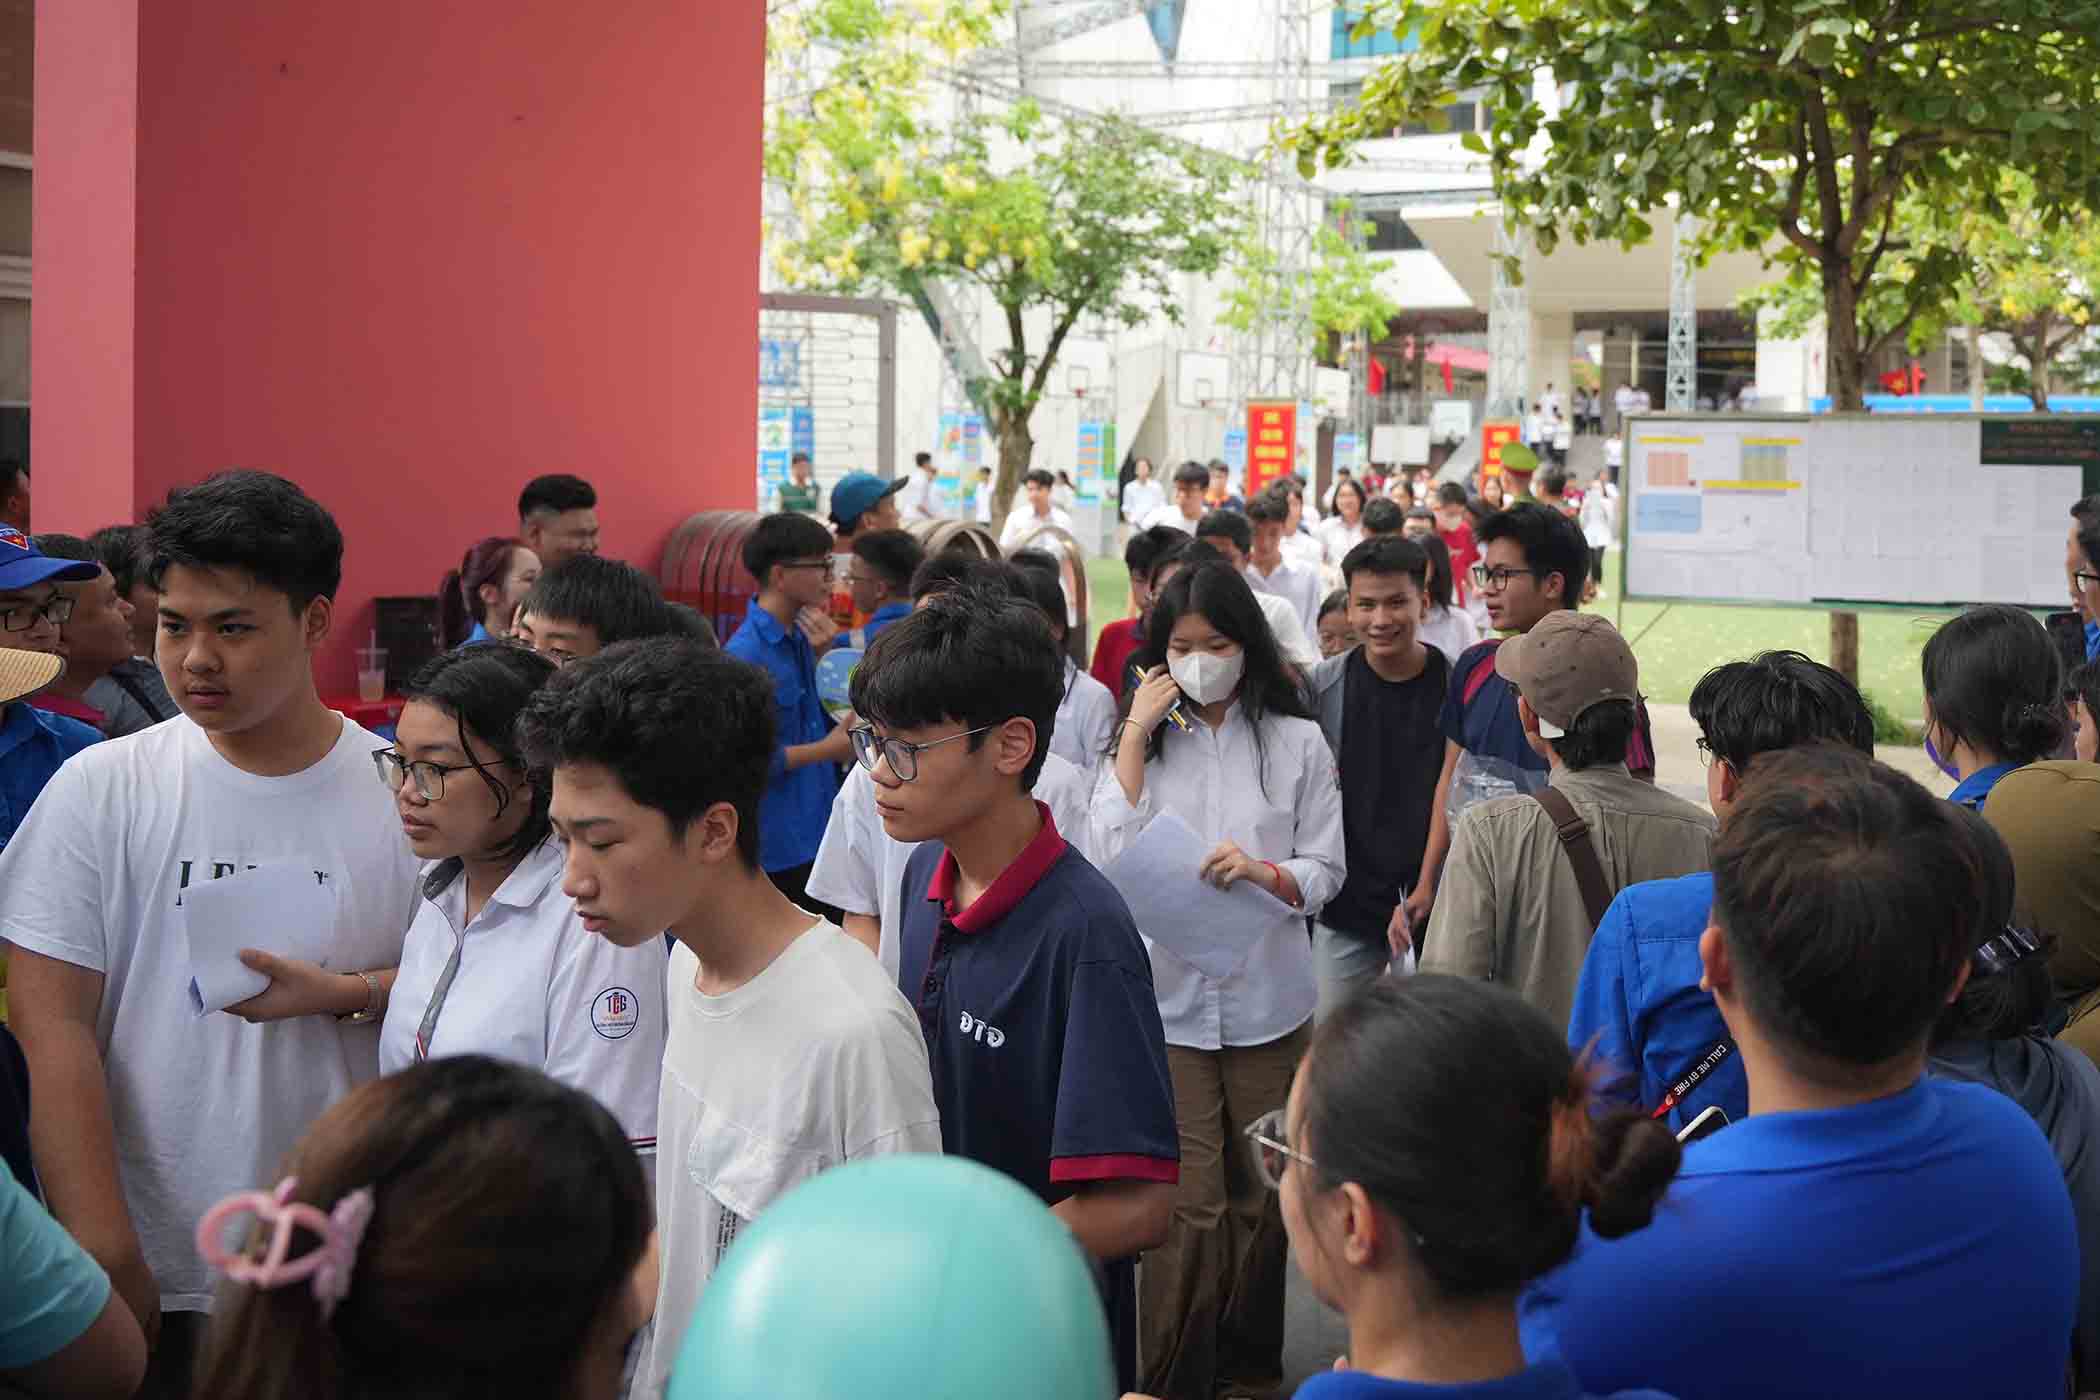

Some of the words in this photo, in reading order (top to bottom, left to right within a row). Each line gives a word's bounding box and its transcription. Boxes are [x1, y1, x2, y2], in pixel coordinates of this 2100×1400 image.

[1707, 1044, 1727, 1063] CALL
[1696, 1060, 1710, 1074] ME
[1688, 1071, 1700, 1083] BY
[1674, 1079, 1691, 1096] FIRE
